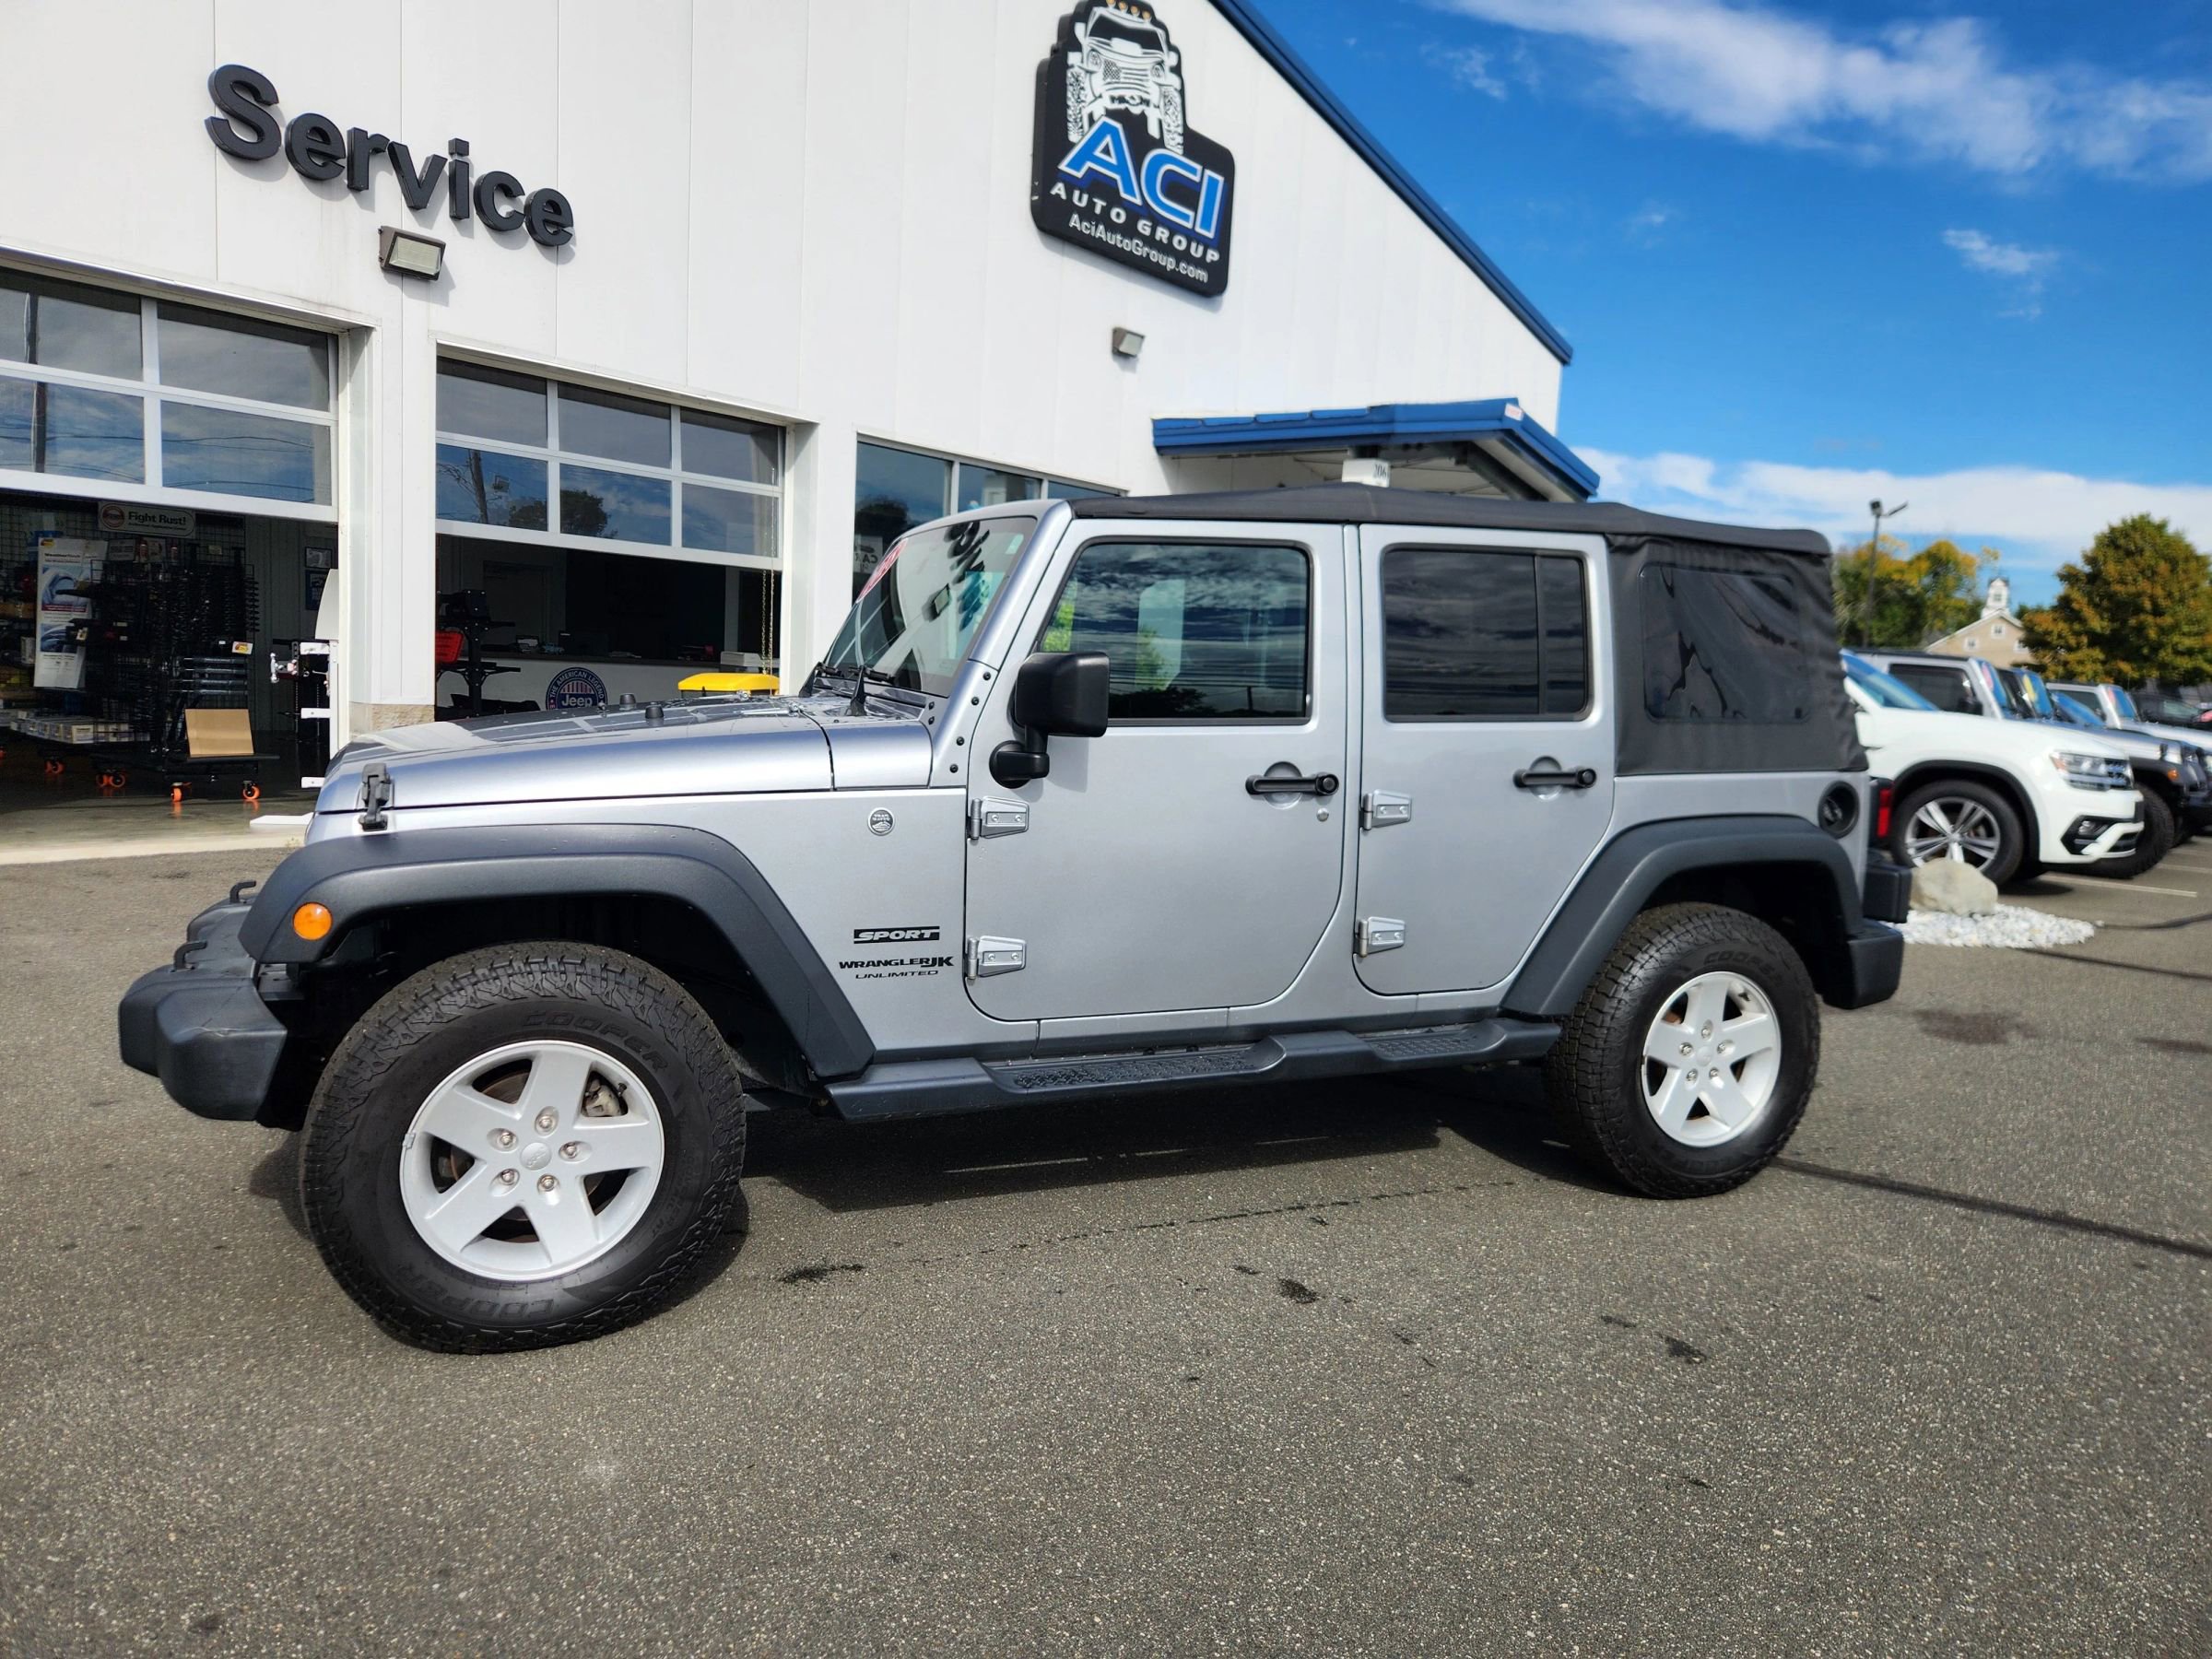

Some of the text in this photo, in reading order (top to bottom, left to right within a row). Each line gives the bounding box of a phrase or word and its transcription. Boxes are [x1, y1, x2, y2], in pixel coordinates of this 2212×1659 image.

[205, 64, 573, 247] Service
[1058, 115, 1225, 240] ACI
[1050, 182, 1219, 264] AUTO GROUP
[1069, 213, 1208, 283] AciAutoGroup.com
[128, 512, 157, 524] Fight
[159, 513, 186, 525] Rust!
[558, 671, 587, 686] AMERICAN
[589, 676, 604, 699] LEGEND
[561, 694, 593, 708] Jeep
[853, 927, 939, 942] SPORT
[855, 970, 938, 979] UNLIMITED
[524, 1012, 668, 1073] COOPER
